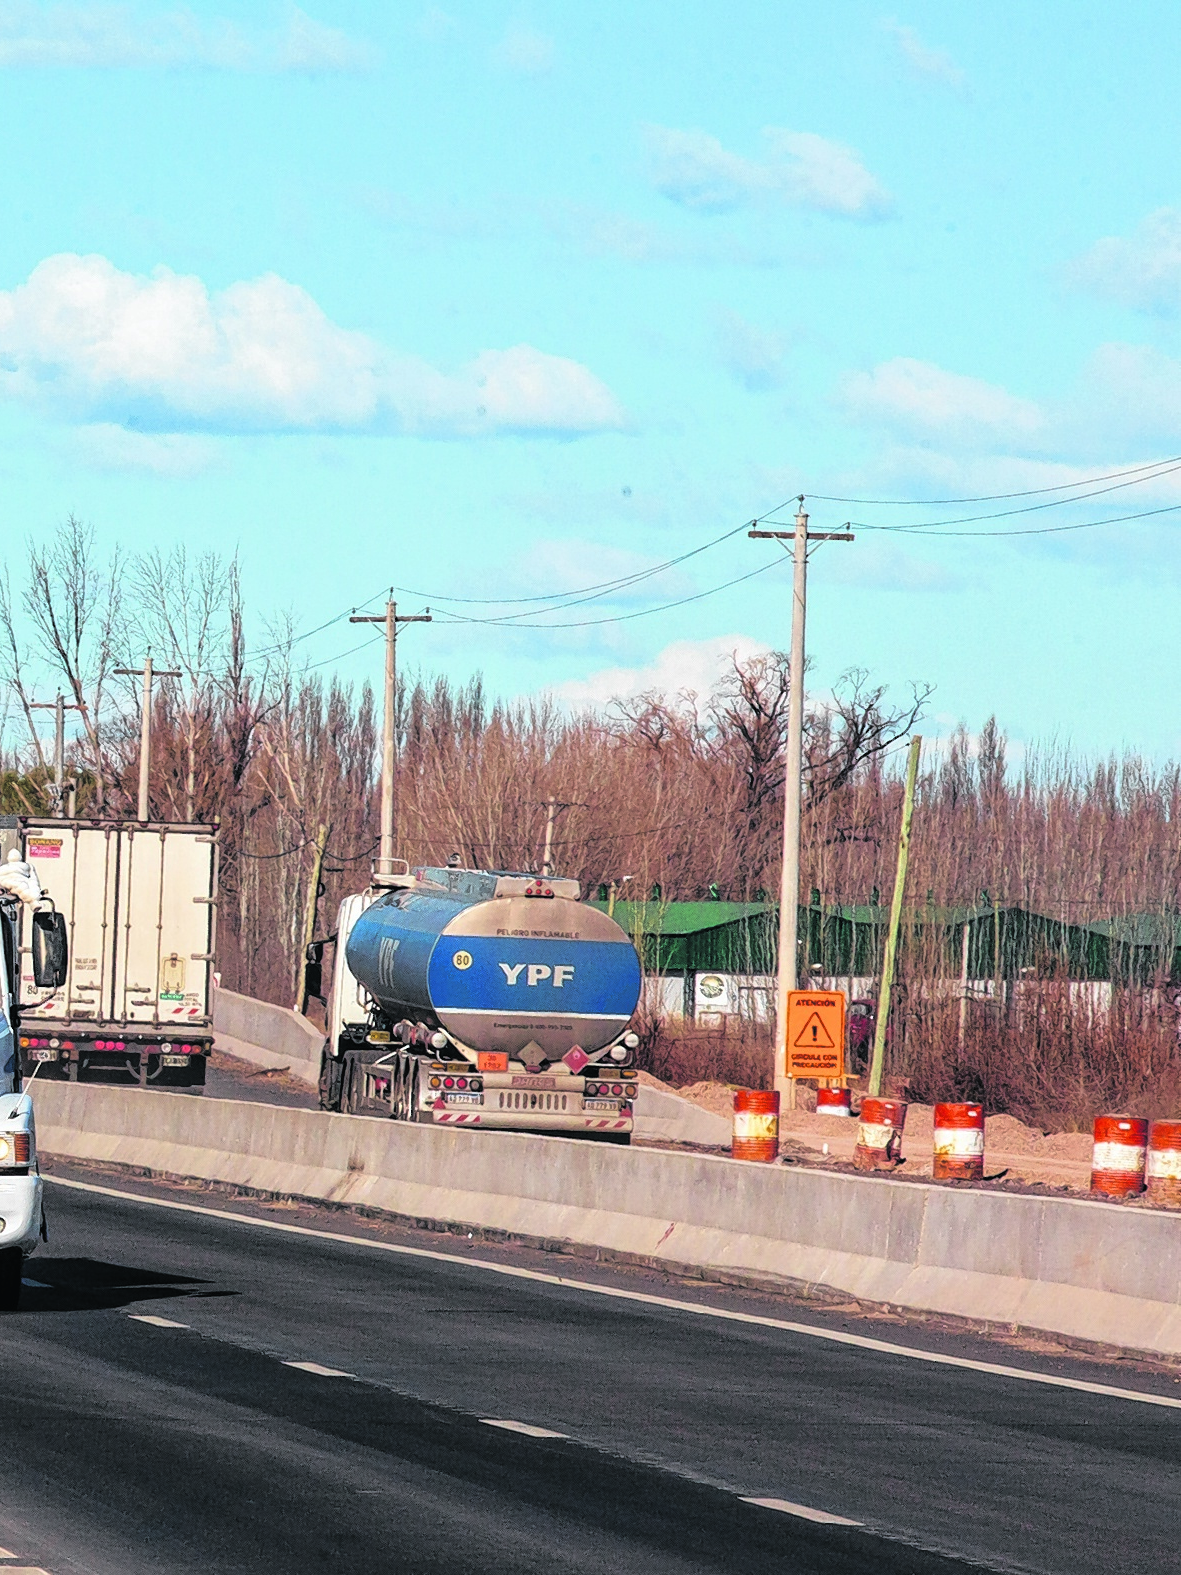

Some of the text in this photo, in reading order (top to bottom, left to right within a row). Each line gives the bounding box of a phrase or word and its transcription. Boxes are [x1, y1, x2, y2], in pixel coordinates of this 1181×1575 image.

[496, 928, 580, 939] PELIGRO INFLAMABLE
[456, 955, 470, 966] 80
[498, 962, 575, 988] YPF
[795, 998, 836, 1007] ATENCIÓN
